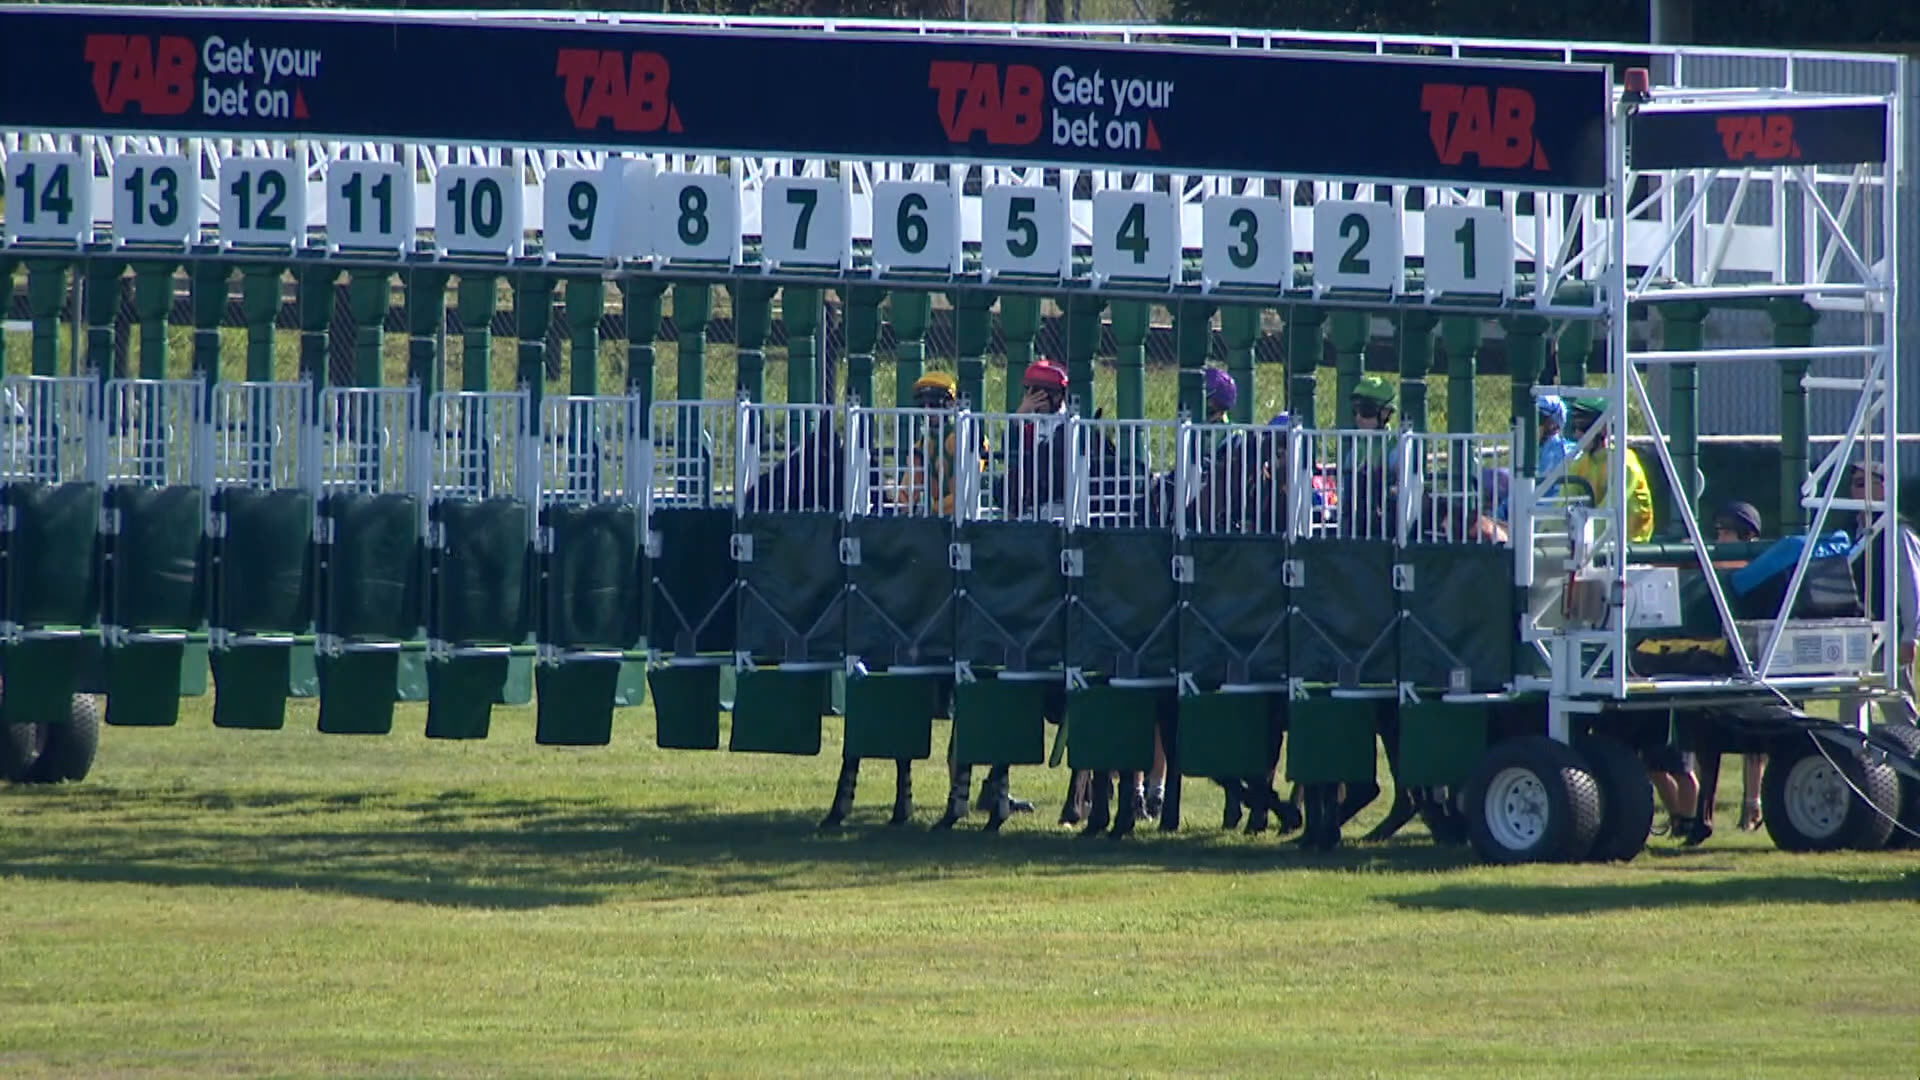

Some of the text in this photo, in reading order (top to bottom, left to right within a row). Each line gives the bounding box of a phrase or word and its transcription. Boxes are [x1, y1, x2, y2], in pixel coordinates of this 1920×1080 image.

[84, 34, 196, 115] TAB
[203, 36, 322, 82] Get your
[1051, 65, 1175, 113] Get your
[203, 78, 289, 118] bet on
[929, 61, 1043, 145] TAB
[1052, 107, 1142, 150] bet on
[15, 163, 74, 225] 14
[124, 166, 179, 227] 13
[231, 169, 287, 231] 12
[341, 172, 392, 234] 11
[447, 177, 503, 239] 10
[567, 180, 598, 241] 9
[677, 185, 709, 246] 8
[786, 188, 818, 250] 7
[896, 193, 929, 254] 6
[1006, 196, 1038, 258] 5
[1116, 203, 1150, 264] 4
[1227, 208, 1259, 269] 3
[1338, 213, 1370, 274] 2
[1453, 217, 1477, 279] 1
